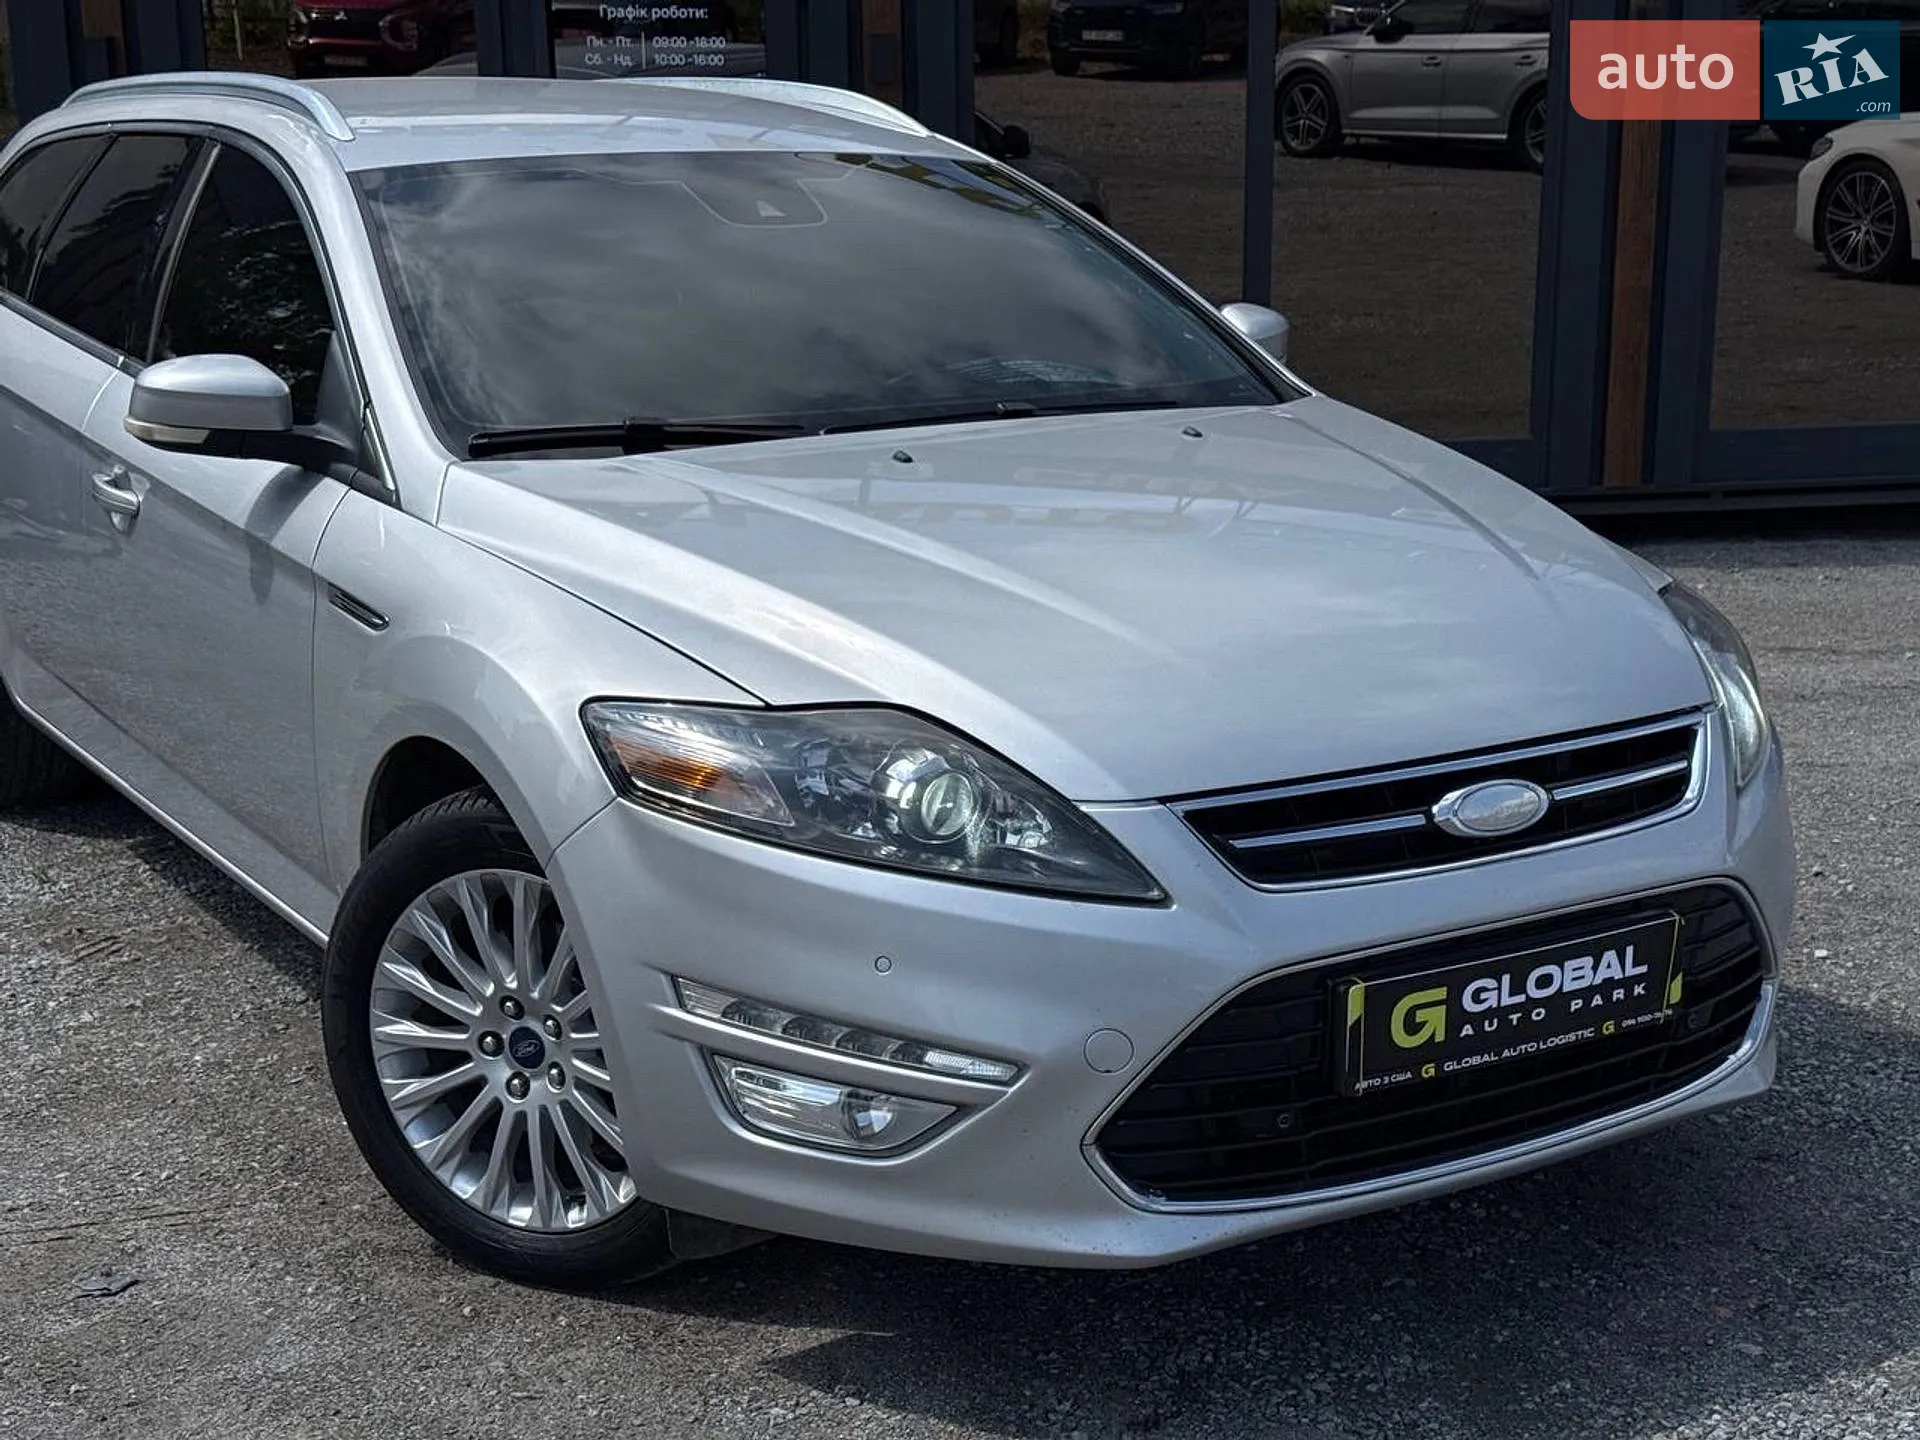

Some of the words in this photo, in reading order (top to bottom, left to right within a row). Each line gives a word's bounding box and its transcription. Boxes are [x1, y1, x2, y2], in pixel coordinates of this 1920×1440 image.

[599, 4, 649, 20] Графік
[651, 5, 708, 20] роботи:
[654, 53, 686, 65] 10:00
[1462, 945, 1648, 1014] GLOBAL
[1459, 1007, 1547, 1037] AUTO
[1570, 982, 1648, 1013] PARK
[1443, 1051, 1498, 1072] GLOBAL
[1501, 1041, 1538, 1059] AUTO
[1539, 1027, 1595, 1049] LOGISTIC
